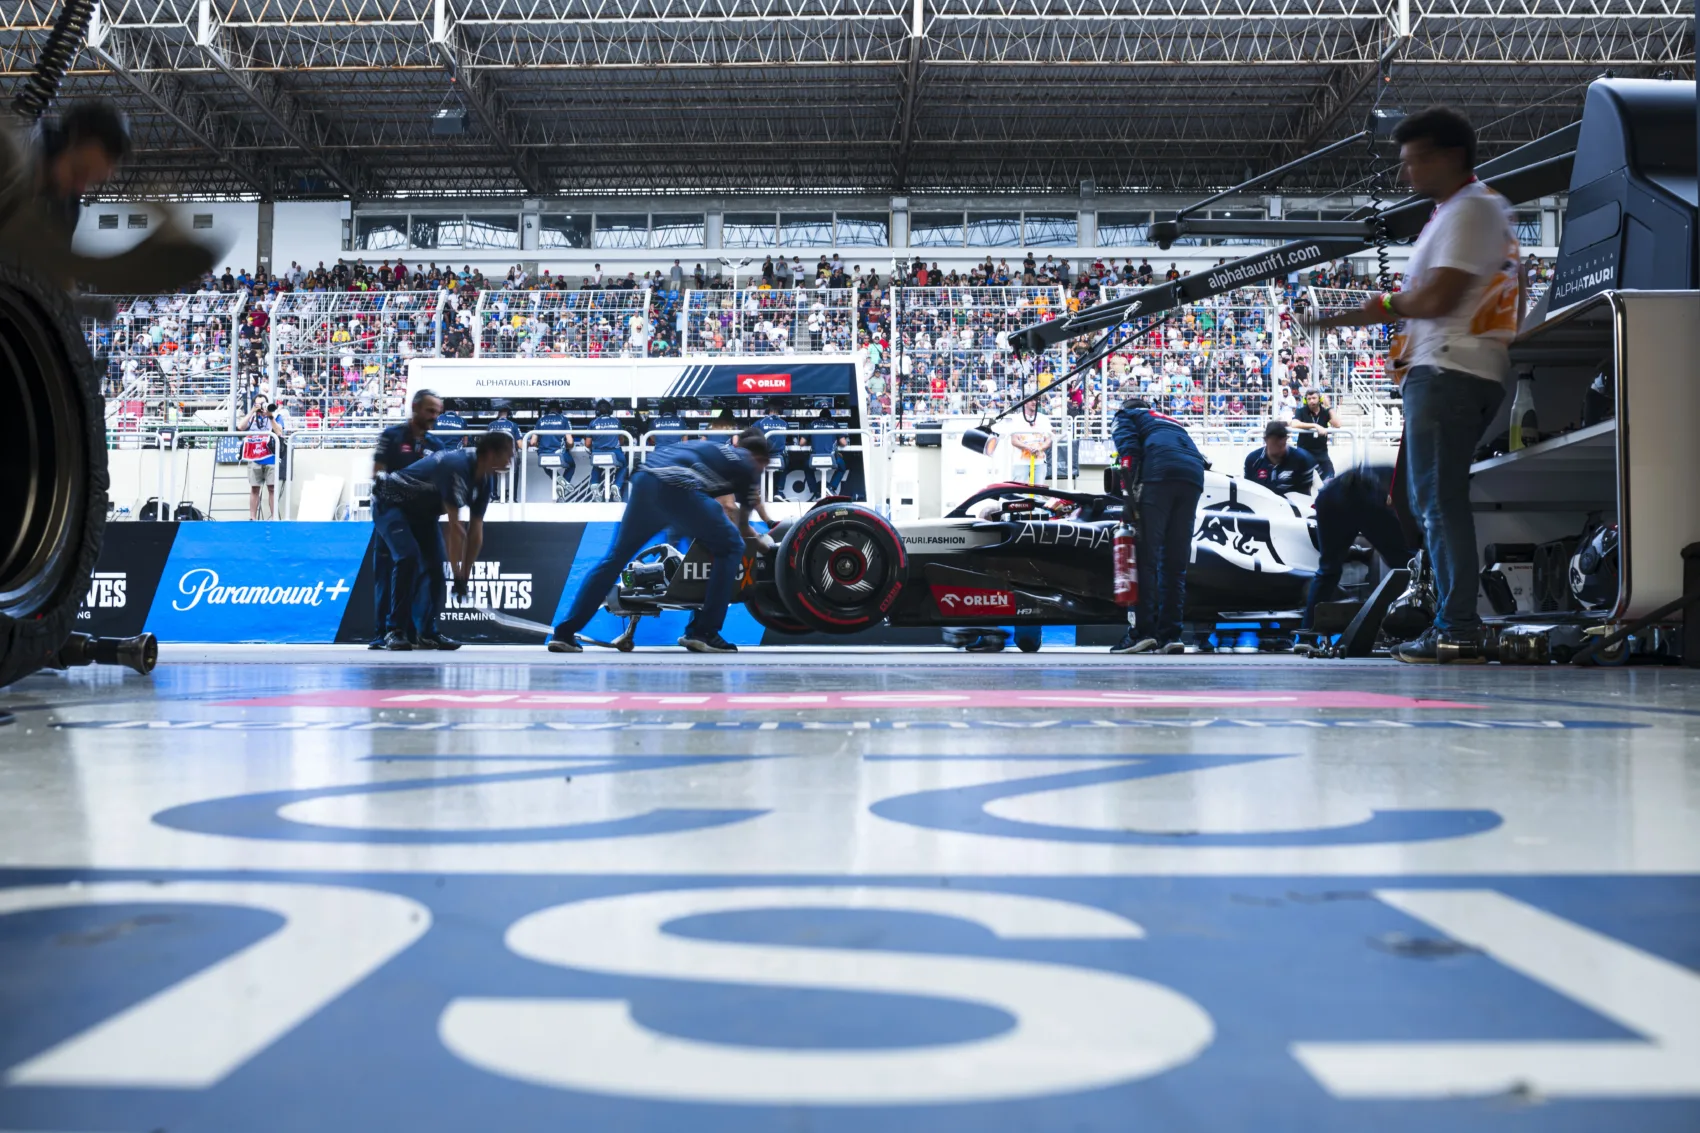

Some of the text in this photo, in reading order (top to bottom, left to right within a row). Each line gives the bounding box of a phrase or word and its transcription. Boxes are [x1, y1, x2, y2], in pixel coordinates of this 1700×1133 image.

[1208, 245, 1321, 289] alphataurif1.com
[1556, 253, 1613, 280] SCUDERIA
[1555, 266, 1613, 299] ALPHATAURI
[475, 379, 571, 387] ALPHATAURI.FASHION
[757, 379, 786, 388] ORLEN
[172, 568, 350, 611] Paramount+
[963, 594, 1008, 606] ORLEN
[440, 612, 496, 621] STREAMING
